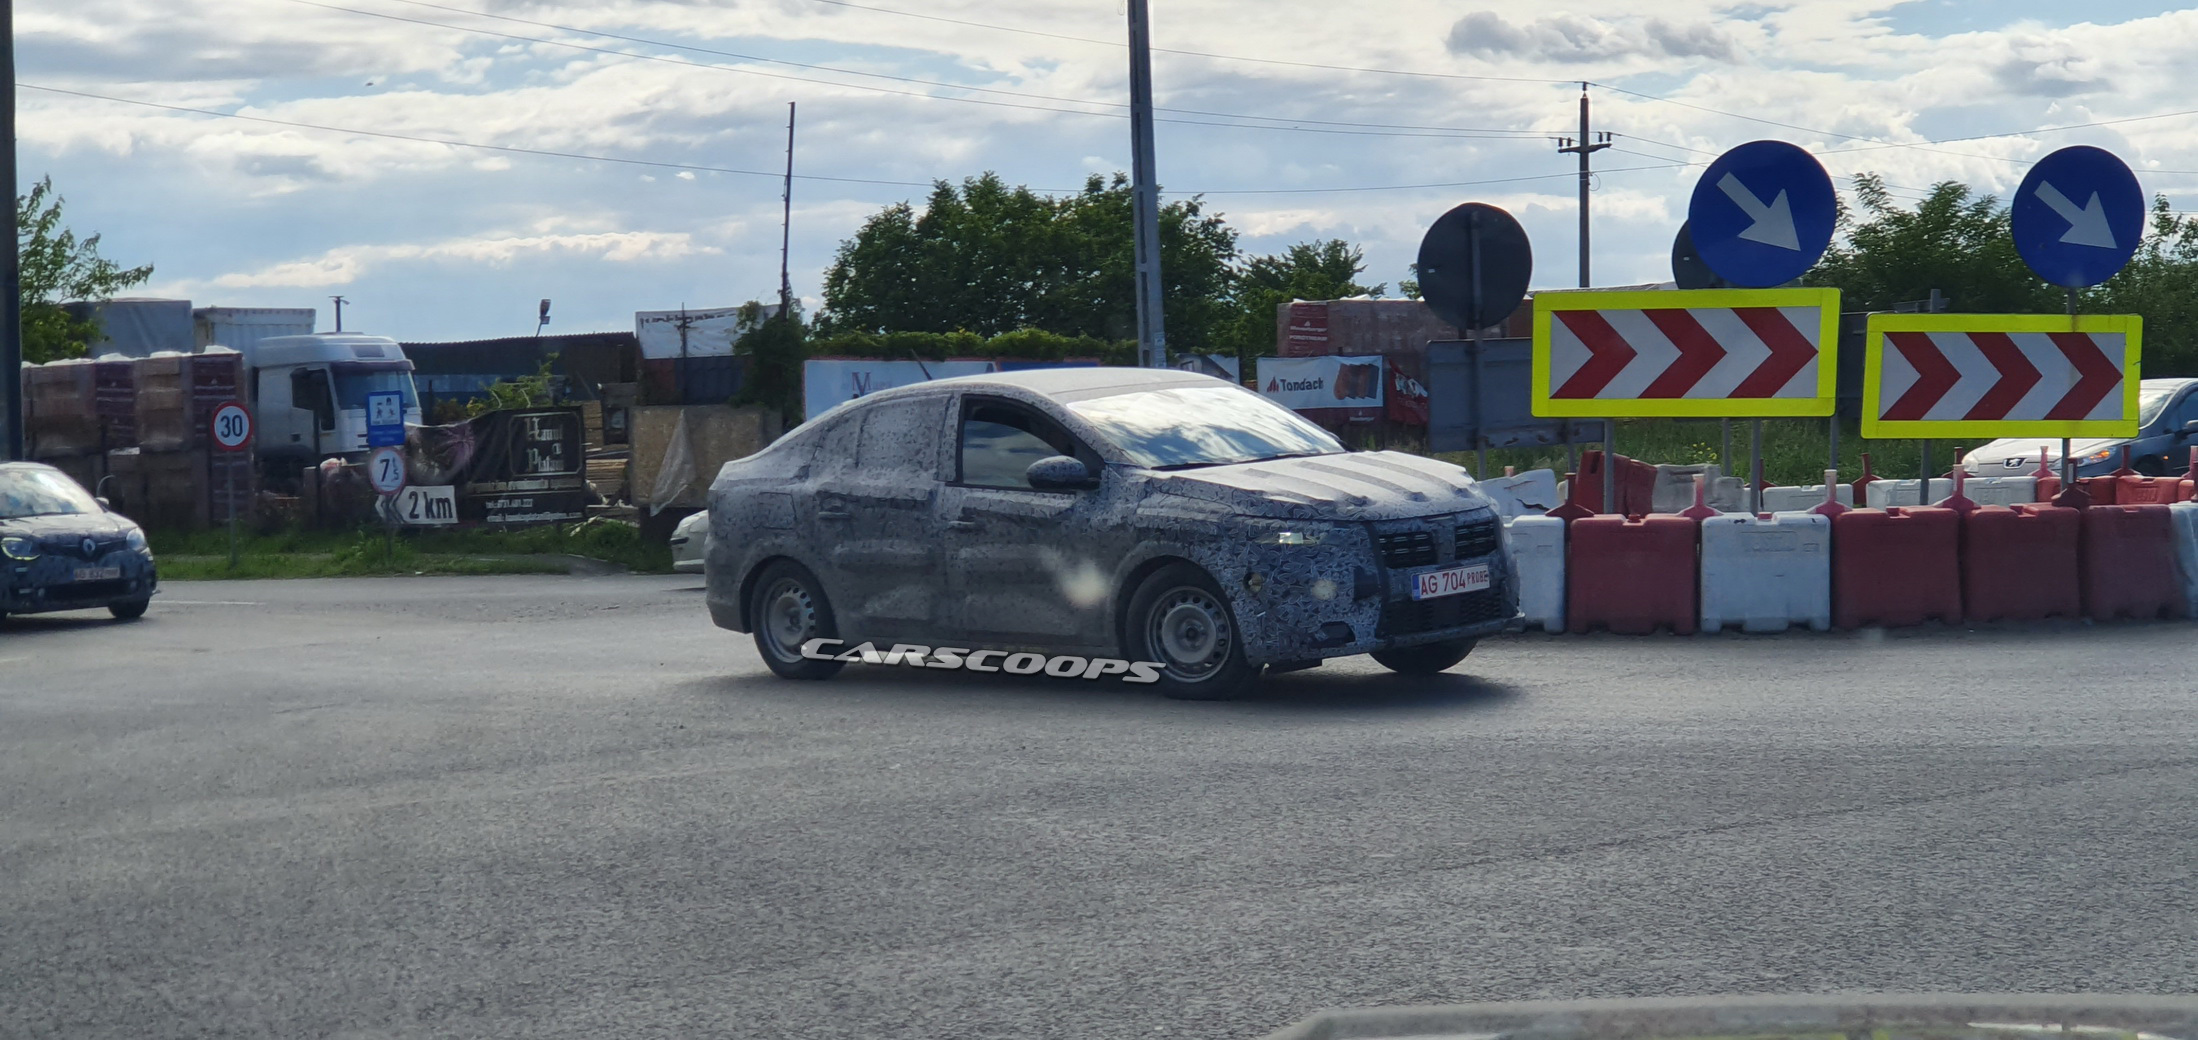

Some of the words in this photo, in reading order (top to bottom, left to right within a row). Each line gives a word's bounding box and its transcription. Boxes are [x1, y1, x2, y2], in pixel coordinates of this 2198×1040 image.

[1279, 376, 1325, 392] Tondach
[219, 414, 244, 438] 30
[408, 490, 420, 519] 2
[424, 490, 453, 519] km
[1420, 575, 1438, 596] AG
[1442, 570, 1466, 592] 704
[1467, 570, 1489, 585] PROBE
